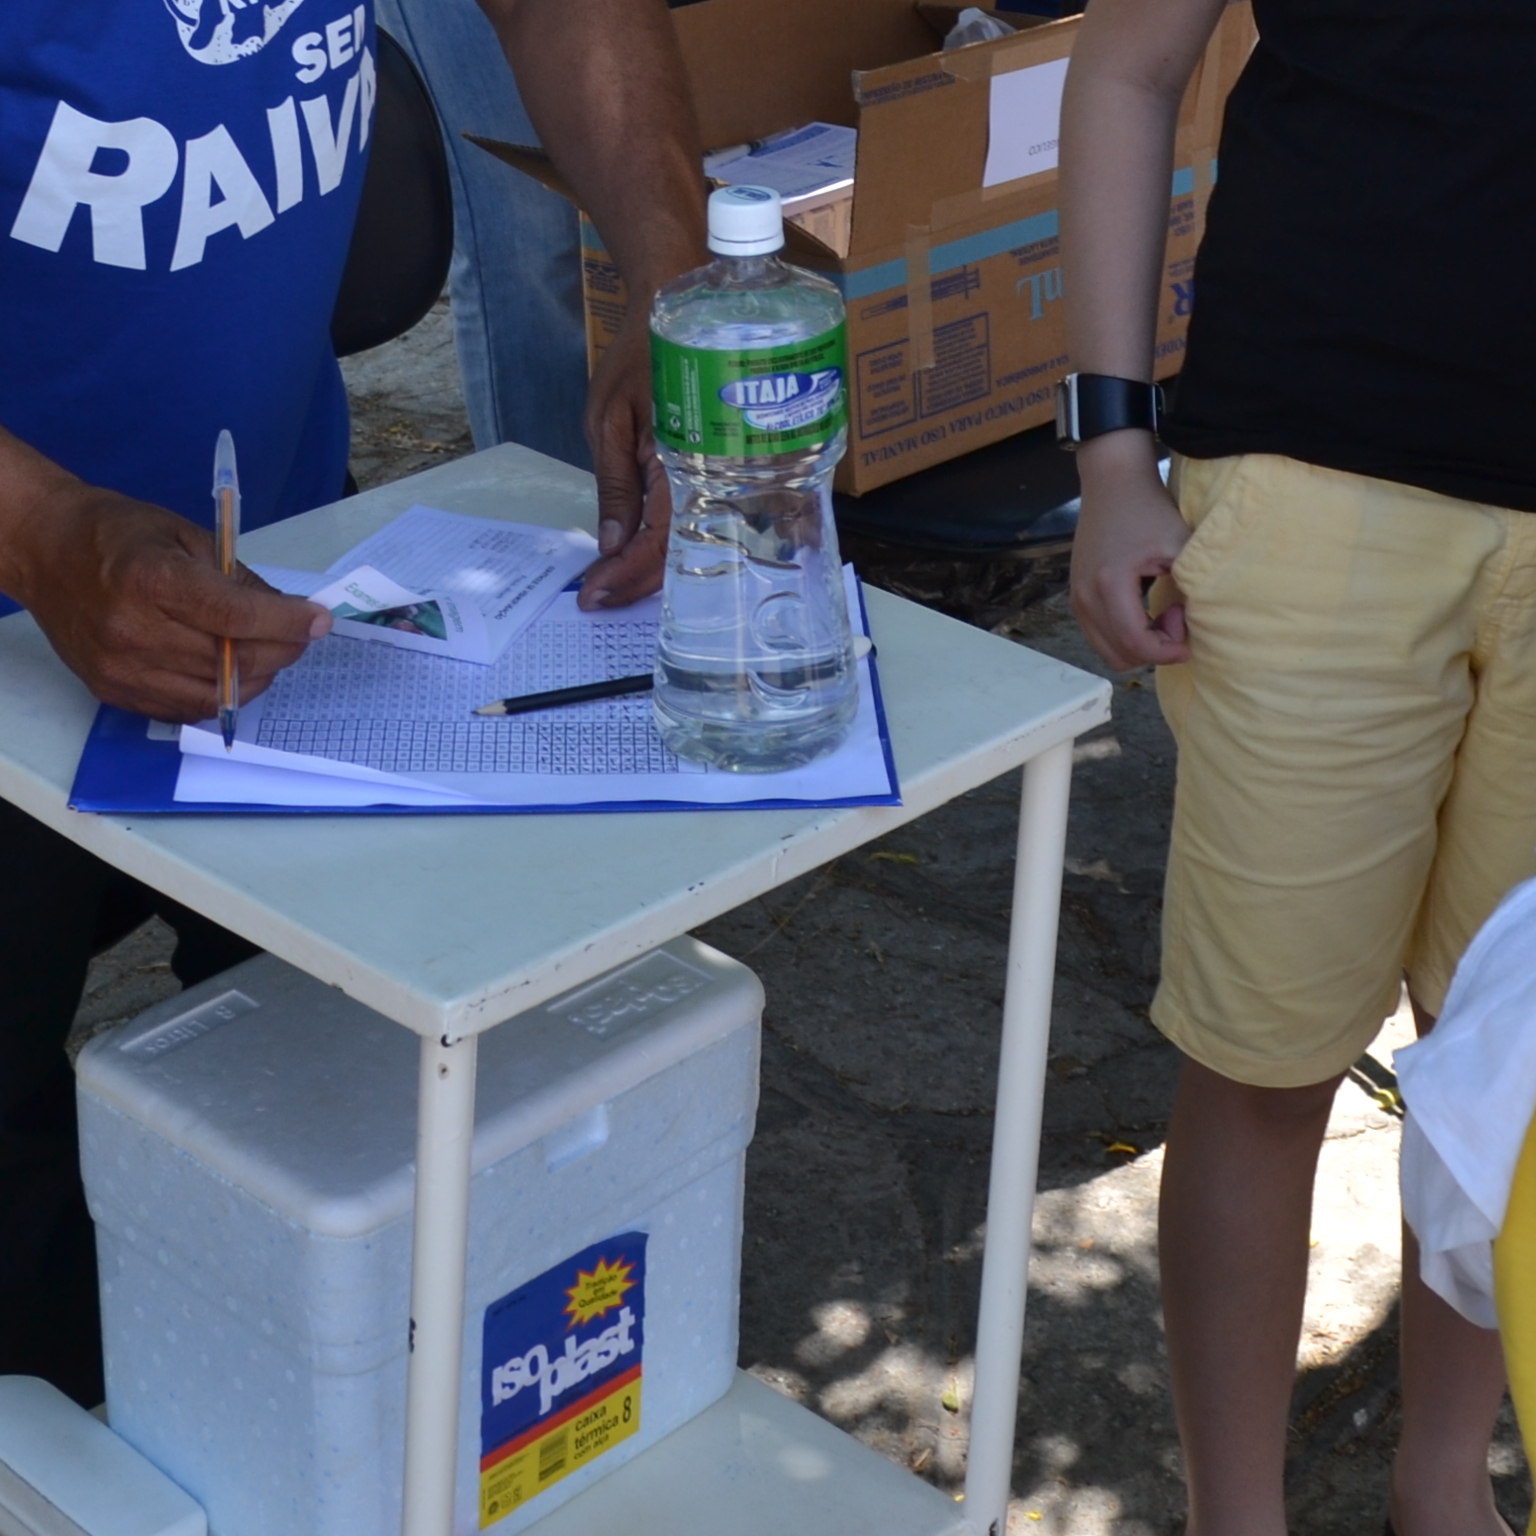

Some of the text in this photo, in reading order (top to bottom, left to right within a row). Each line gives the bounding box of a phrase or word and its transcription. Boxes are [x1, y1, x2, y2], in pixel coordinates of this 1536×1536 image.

[575, 1395, 632, 1432] caixa 8
[574, 1415, 619, 1450] térmica
